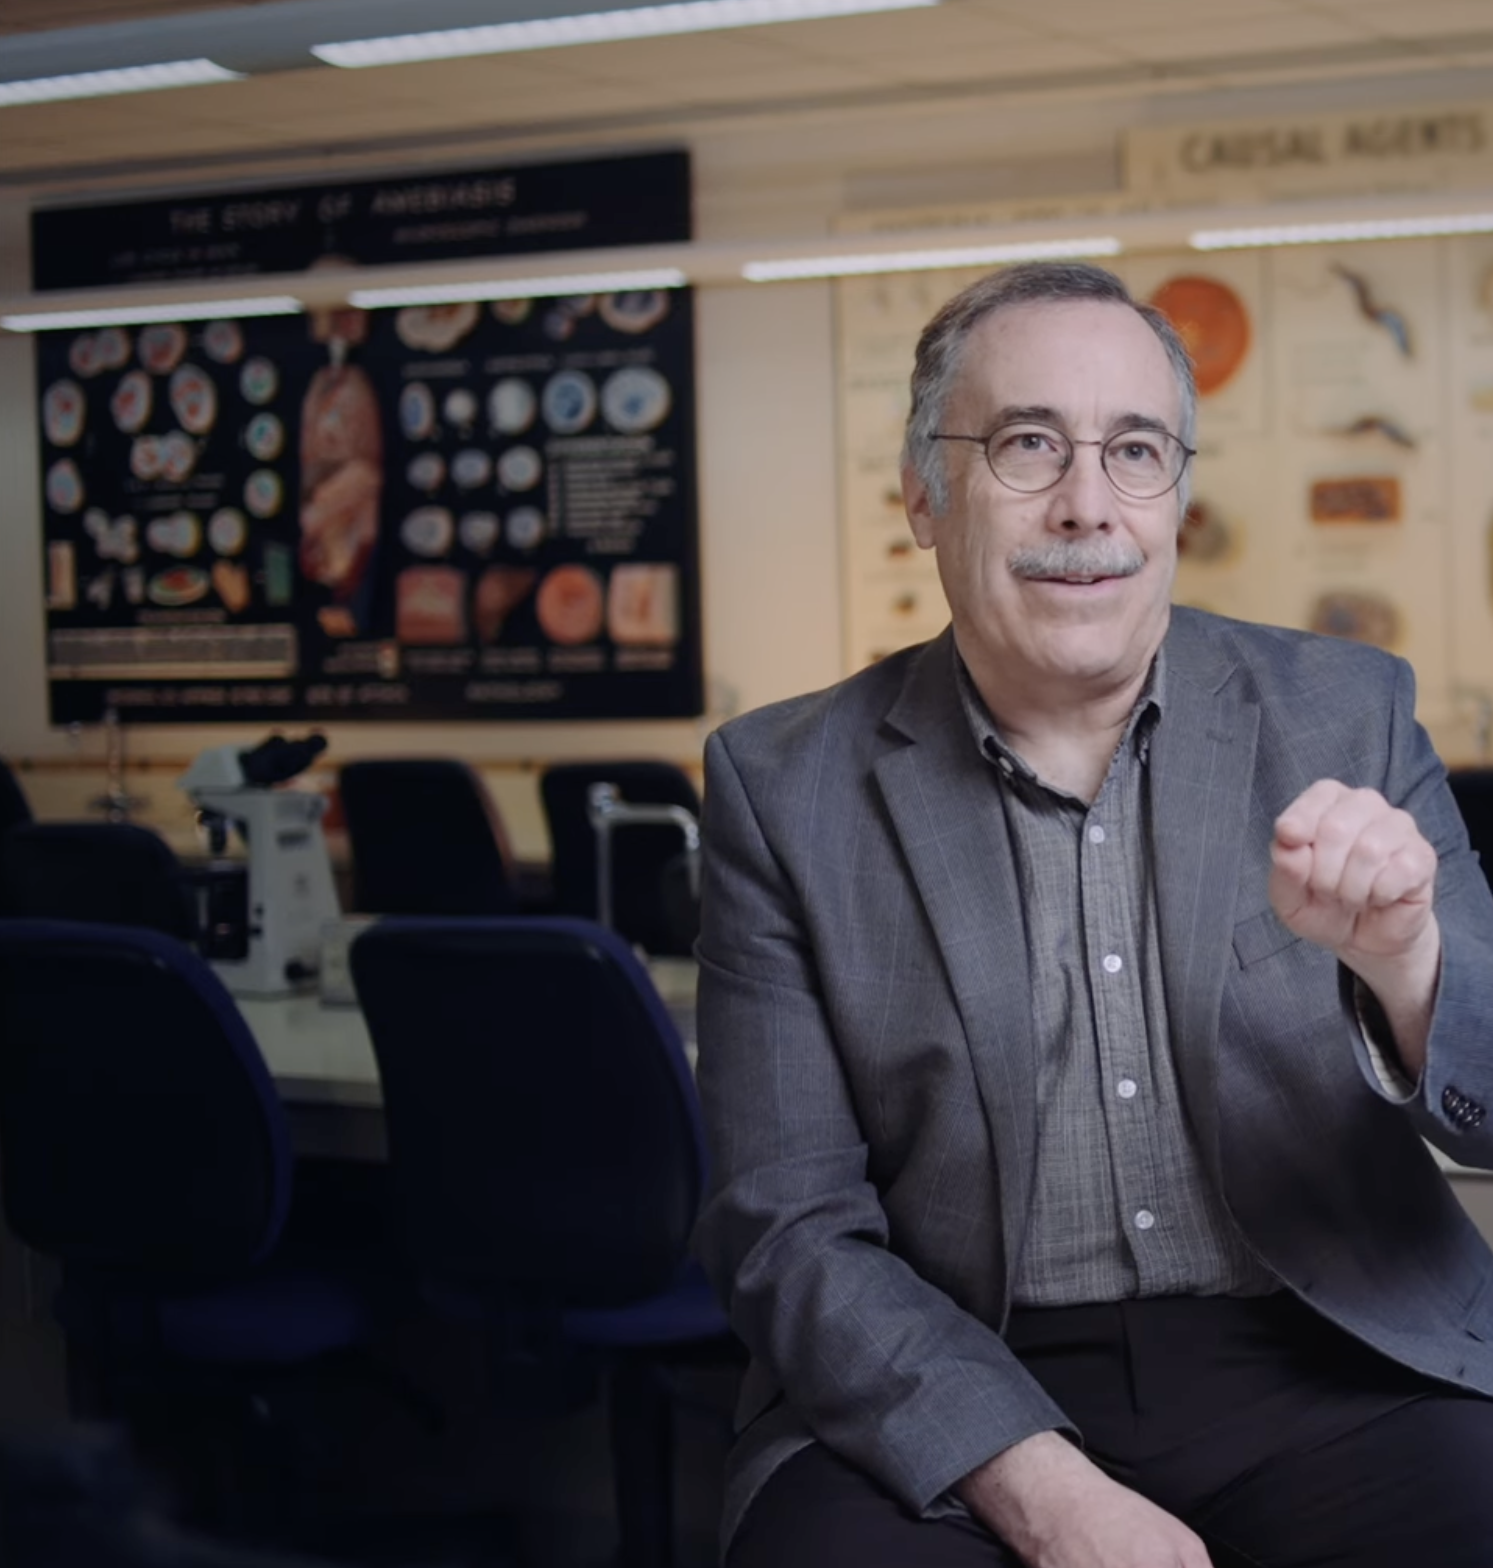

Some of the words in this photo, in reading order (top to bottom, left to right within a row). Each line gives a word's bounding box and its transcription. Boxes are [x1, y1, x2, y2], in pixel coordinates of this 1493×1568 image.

[1180, 126, 1326, 171] CAUSAL
[1345, 109, 1484, 157] AGENTS
[170, 207, 212, 234] THE
[223, 199, 301, 232] STORY
[319, 193, 353, 222] OF
